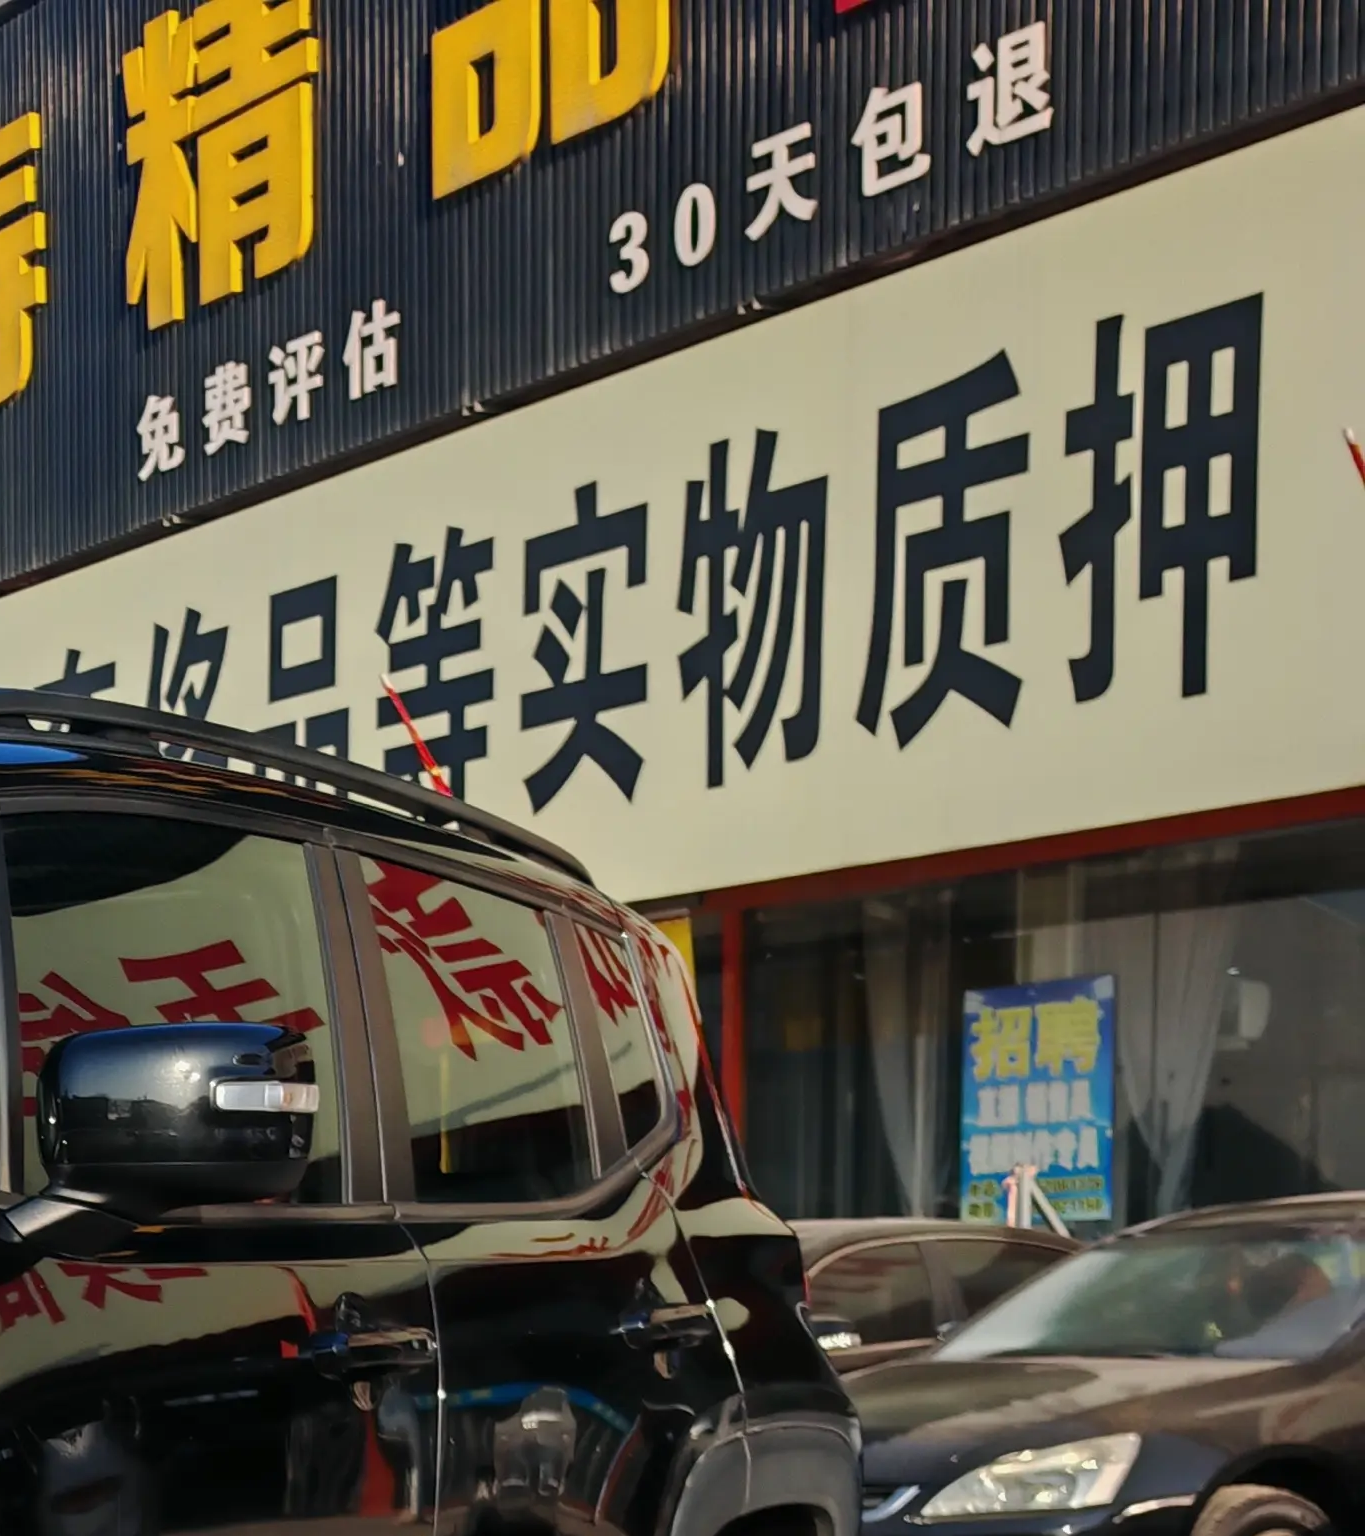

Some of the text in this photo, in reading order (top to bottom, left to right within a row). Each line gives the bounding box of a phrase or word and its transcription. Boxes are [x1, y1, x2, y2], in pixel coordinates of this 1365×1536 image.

[608, 20, 1054, 294] 30天包退
[136, 298, 403, 483] 免费评估
